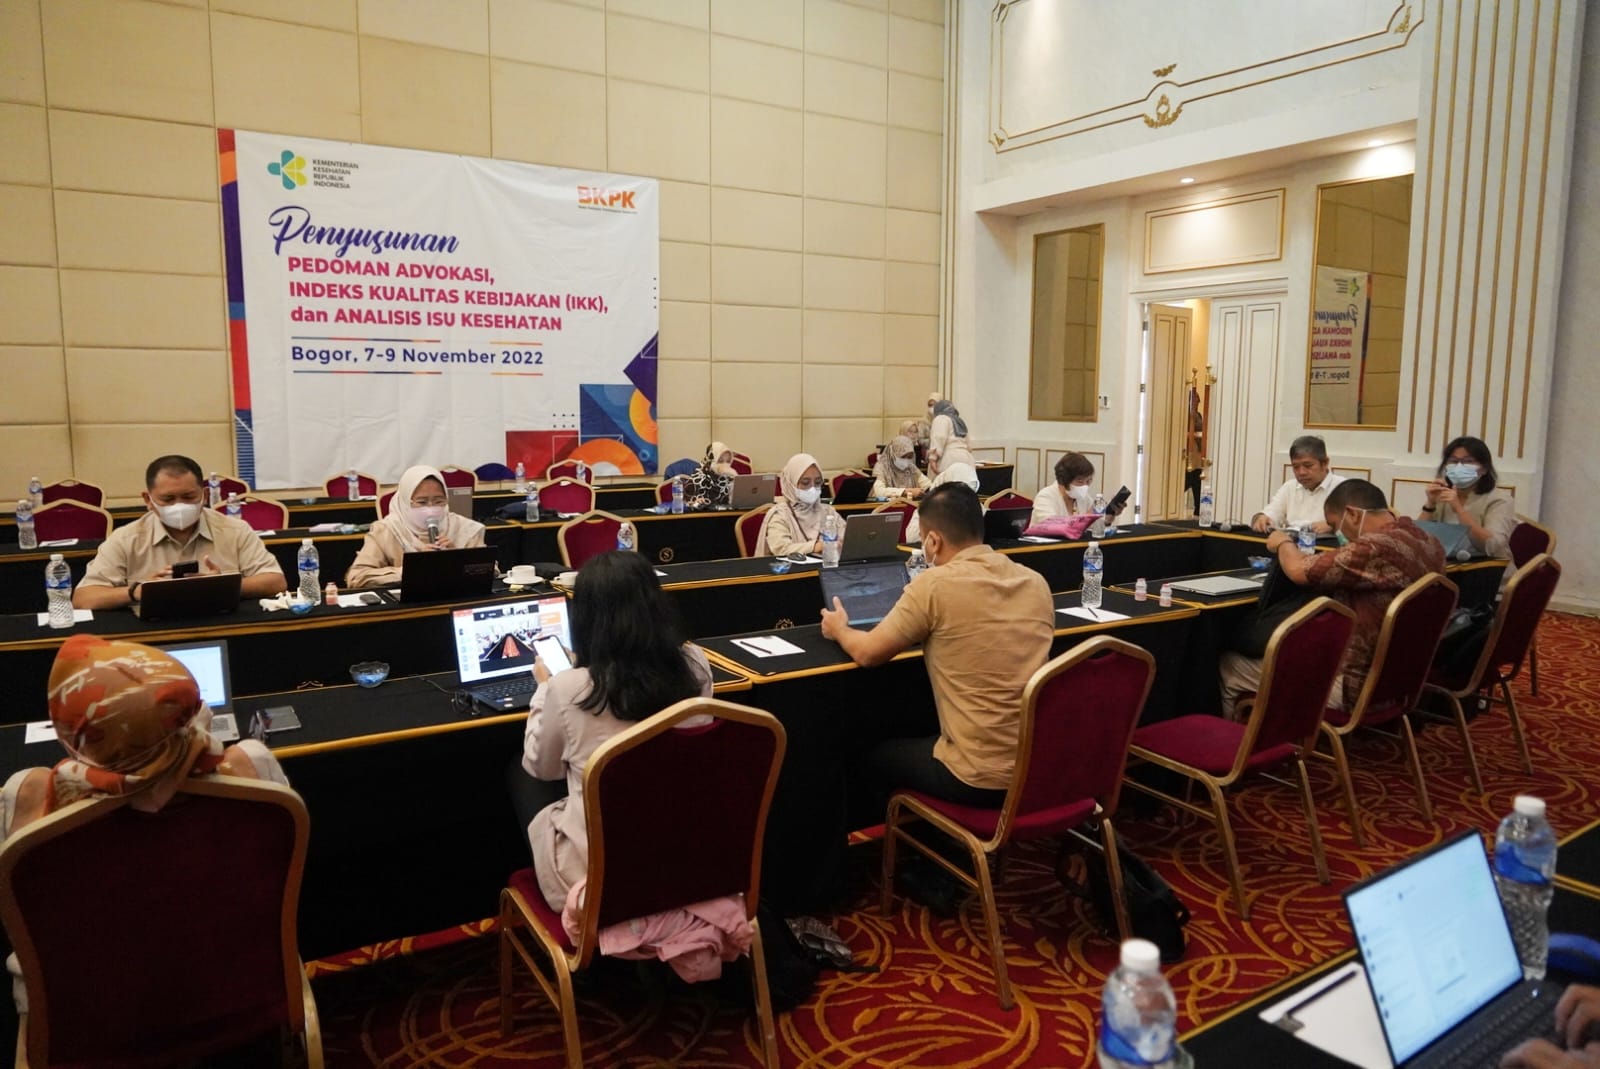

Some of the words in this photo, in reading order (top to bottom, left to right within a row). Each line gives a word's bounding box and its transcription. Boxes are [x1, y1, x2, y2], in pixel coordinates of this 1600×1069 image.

[312, 159, 359, 169] KEMENTERIAN
[313, 166, 351, 175] KESEHATAN
[313, 173, 344, 181] REPUBLIK
[313, 180, 351, 189] INDONESIA
[577, 186, 636, 209] BKPK
[268, 205, 460, 258] Penyusunan
[288, 257, 390, 276] PEDOMAN
[395, 263, 495, 285] ADVOKASI,
[289, 281, 364, 299] INDEKS
[369, 285, 459, 304] KUALITAS
[464, 290, 561, 309] KEBIJAKAN
[565, 294, 608, 314] (IKK),
[290, 306, 328, 322] dan
[334, 308, 422, 326] ANALISIS
[427, 312, 455, 327] ISU
[461, 313, 562, 331] KESEHATAN
[291, 346, 358, 365] Bogor,
[364, 348, 396, 362] 7-9
[402, 348, 497, 363] November
[502, 351, 544, 364] 2022
